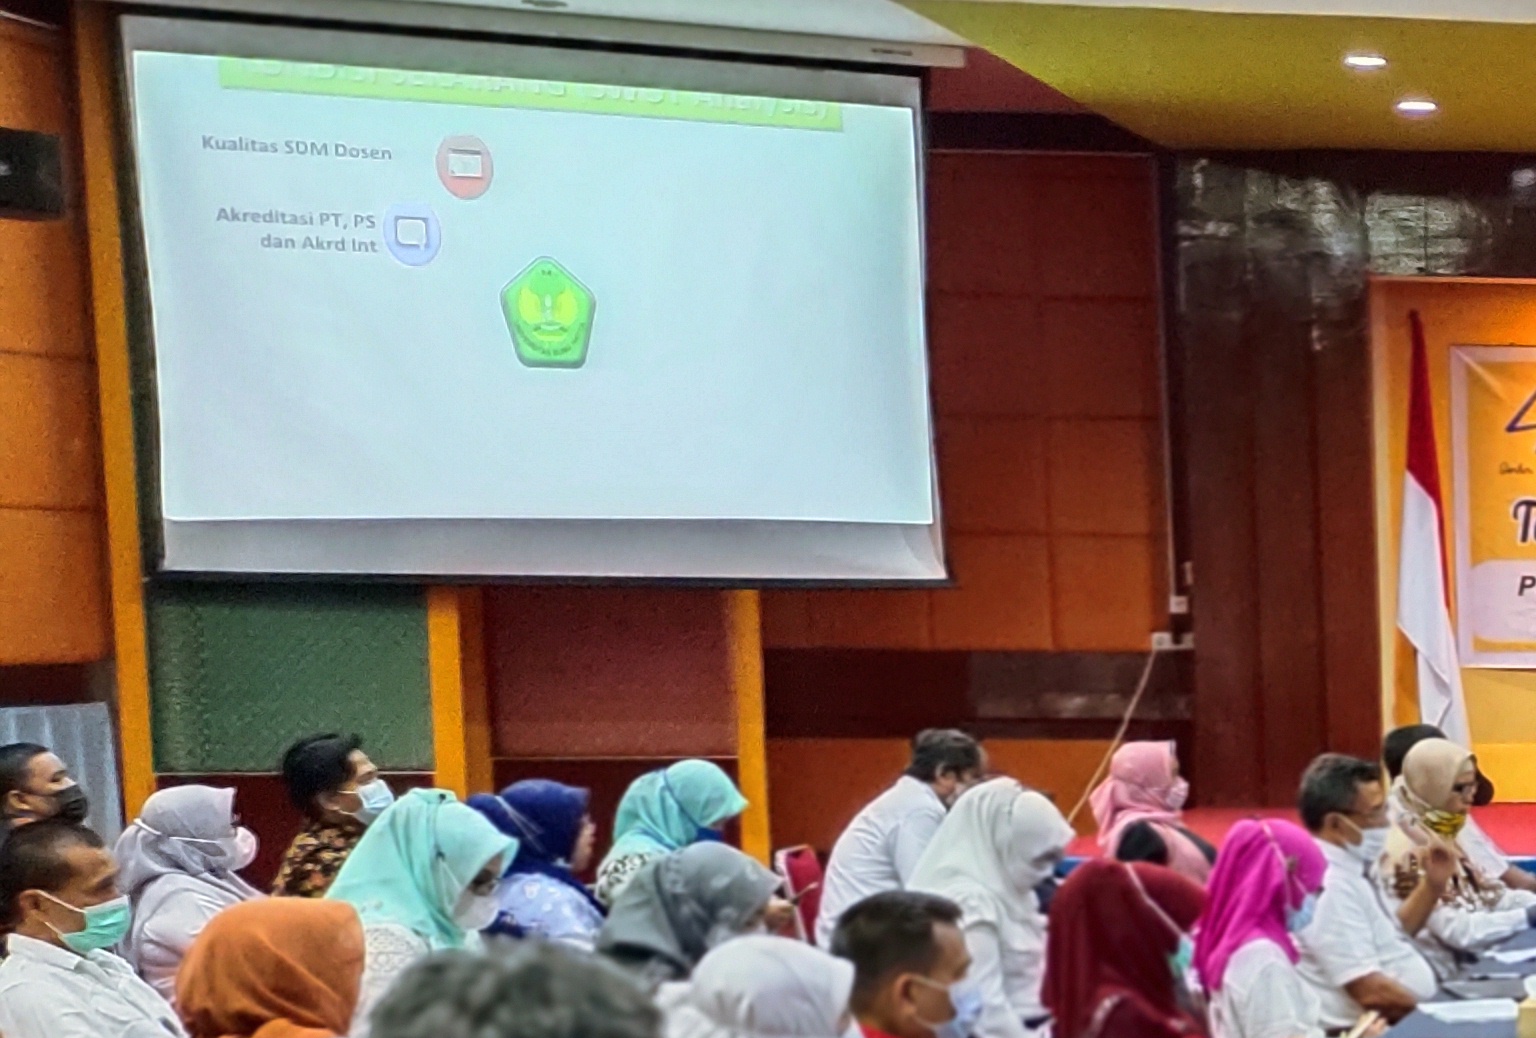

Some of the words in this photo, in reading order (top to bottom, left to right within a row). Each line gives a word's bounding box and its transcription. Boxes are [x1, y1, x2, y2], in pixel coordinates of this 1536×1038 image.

[201, 135, 278, 153] Kualitas
[284, 140, 329, 157] SDM
[334, 143, 392, 160] Dosen
[216, 207, 314, 226] Akreditasi
[319, 212, 348, 230] PT,
[353, 213, 376, 229] PS
[260, 234, 295, 249] dan
[302, 235, 346, 251] Akrd
[351, 238, 378, 253] Int
